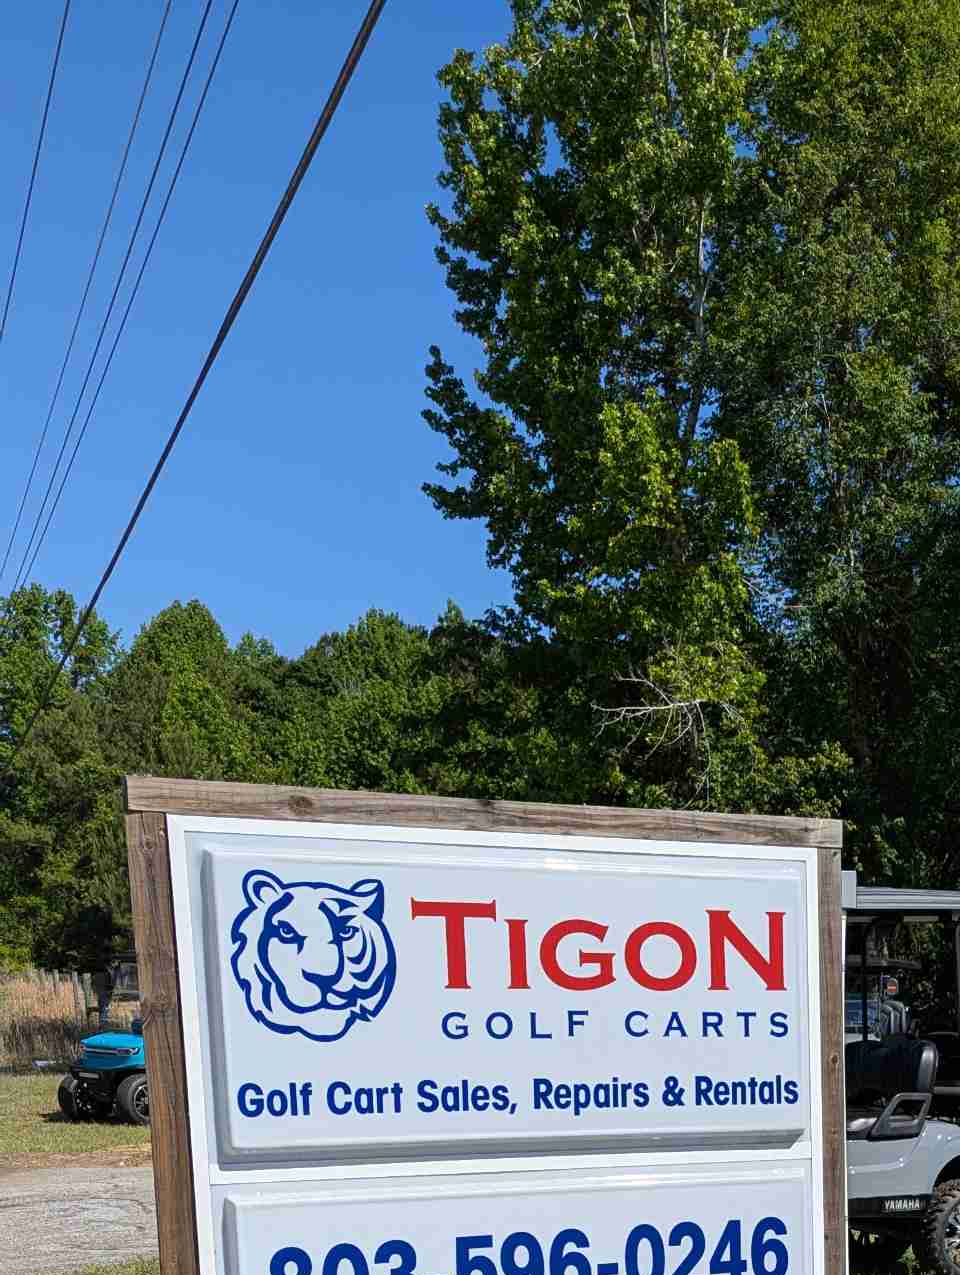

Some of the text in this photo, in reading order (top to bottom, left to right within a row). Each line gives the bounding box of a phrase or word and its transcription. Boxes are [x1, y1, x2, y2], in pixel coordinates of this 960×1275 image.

[442, 1010, 788, 1039] GOLF CARTS
[237, 1075, 798, 1117] Golf Cart Sales, Repairs & Rentals
[884, 1198, 920, 1210] YAMAHA
